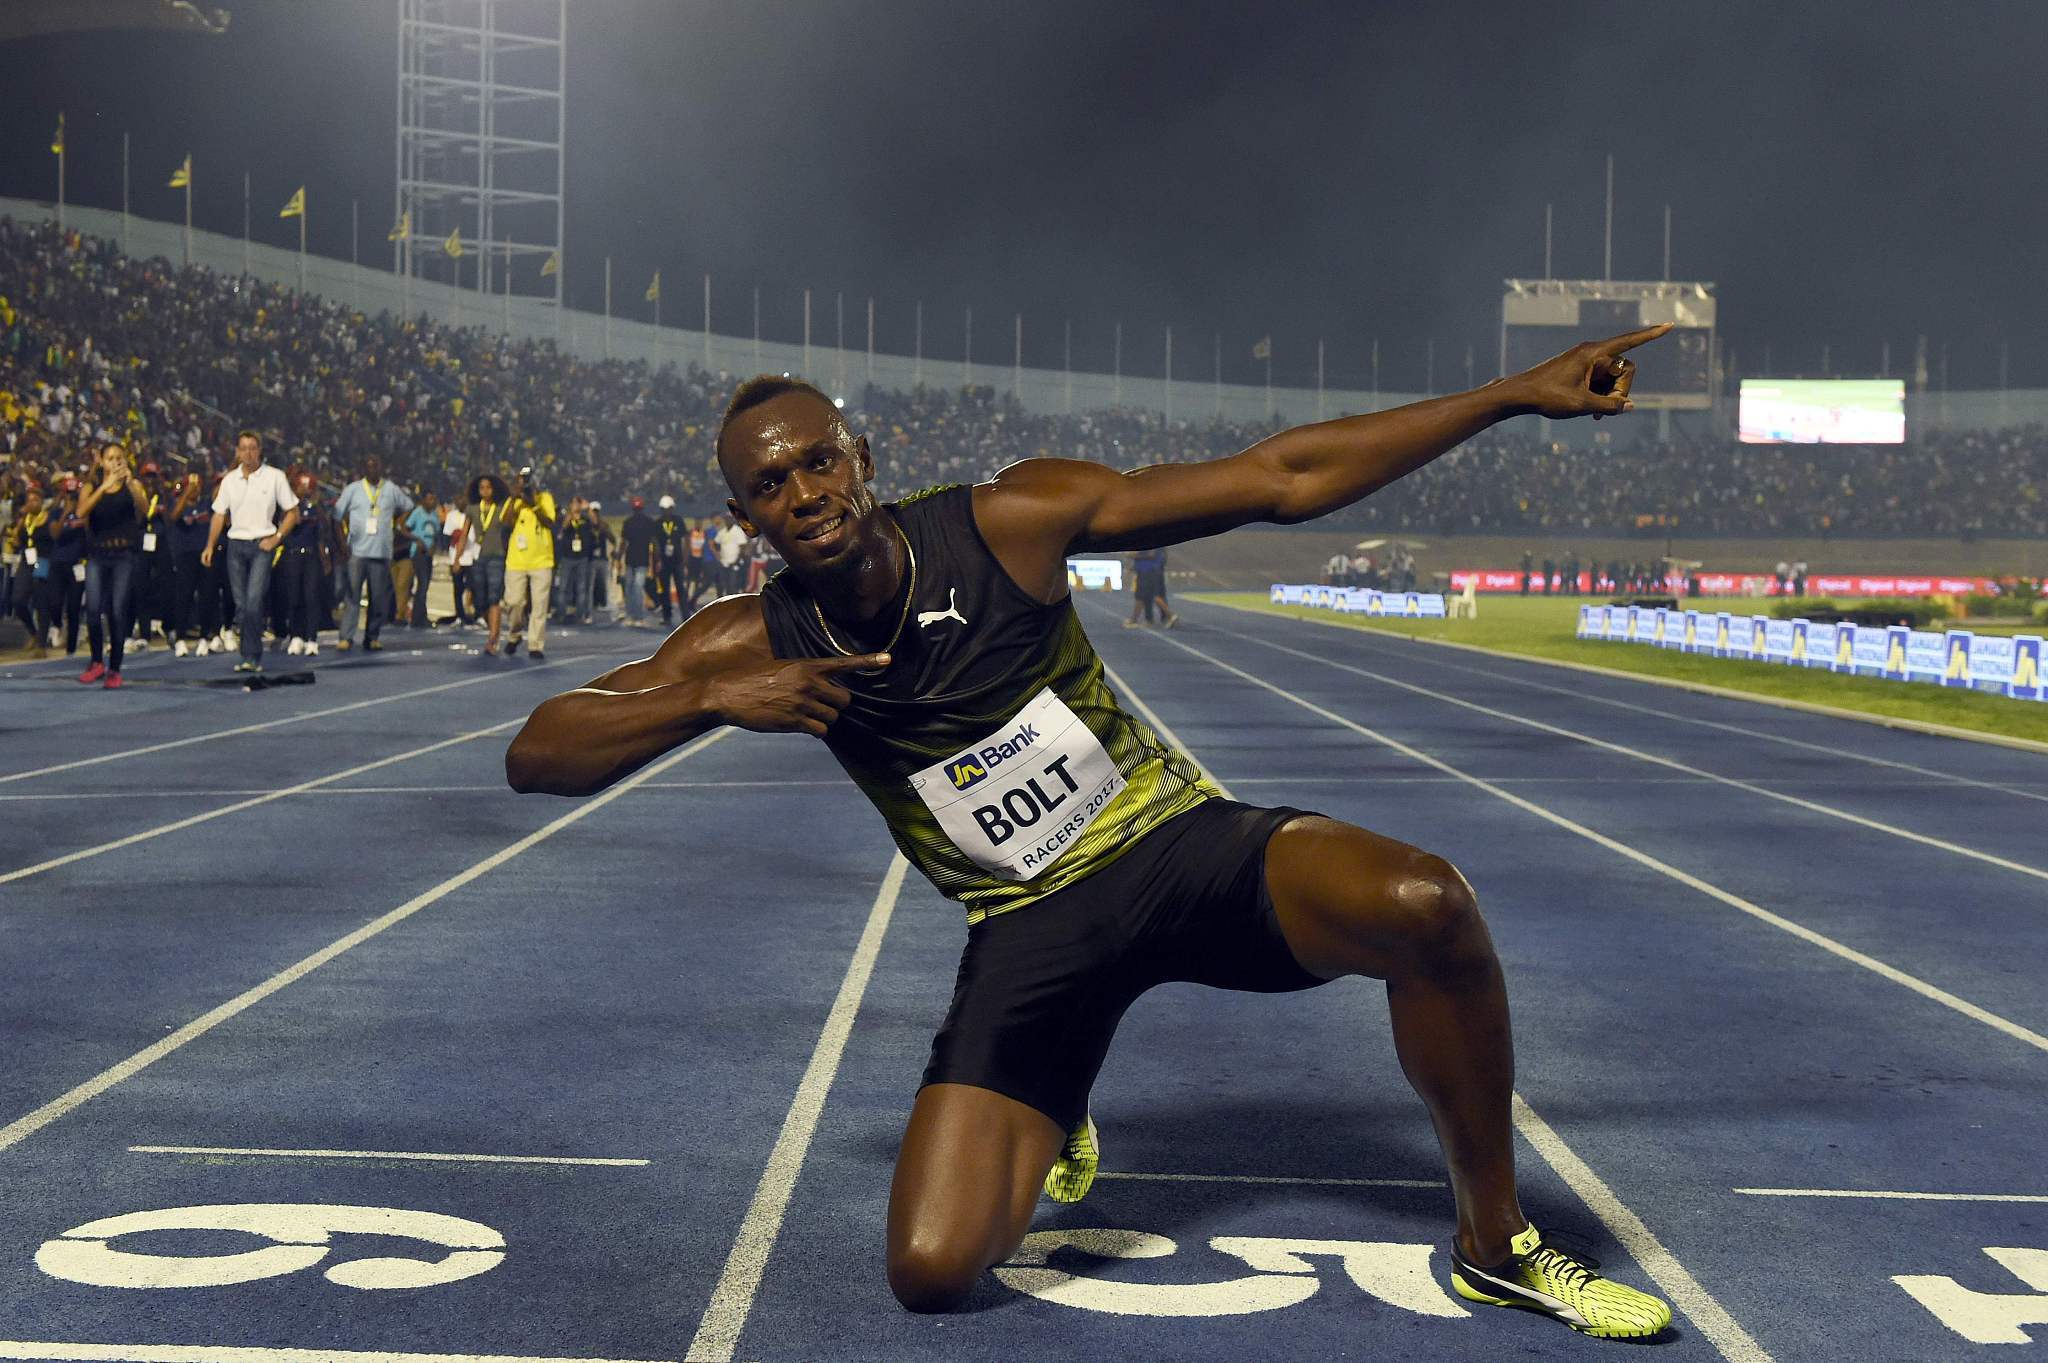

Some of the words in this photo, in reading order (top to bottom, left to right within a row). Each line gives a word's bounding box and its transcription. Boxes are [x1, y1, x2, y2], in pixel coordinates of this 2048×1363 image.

[979, 723, 1041, 768] Bank
[972, 754, 1079, 847] BOLT
[1022, 813, 1085, 868] RACERS
[1086, 778, 1117, 816] 2017
[34, 1203, 507, 1290] 6
[990, 1228, 1472, 1318] 5
